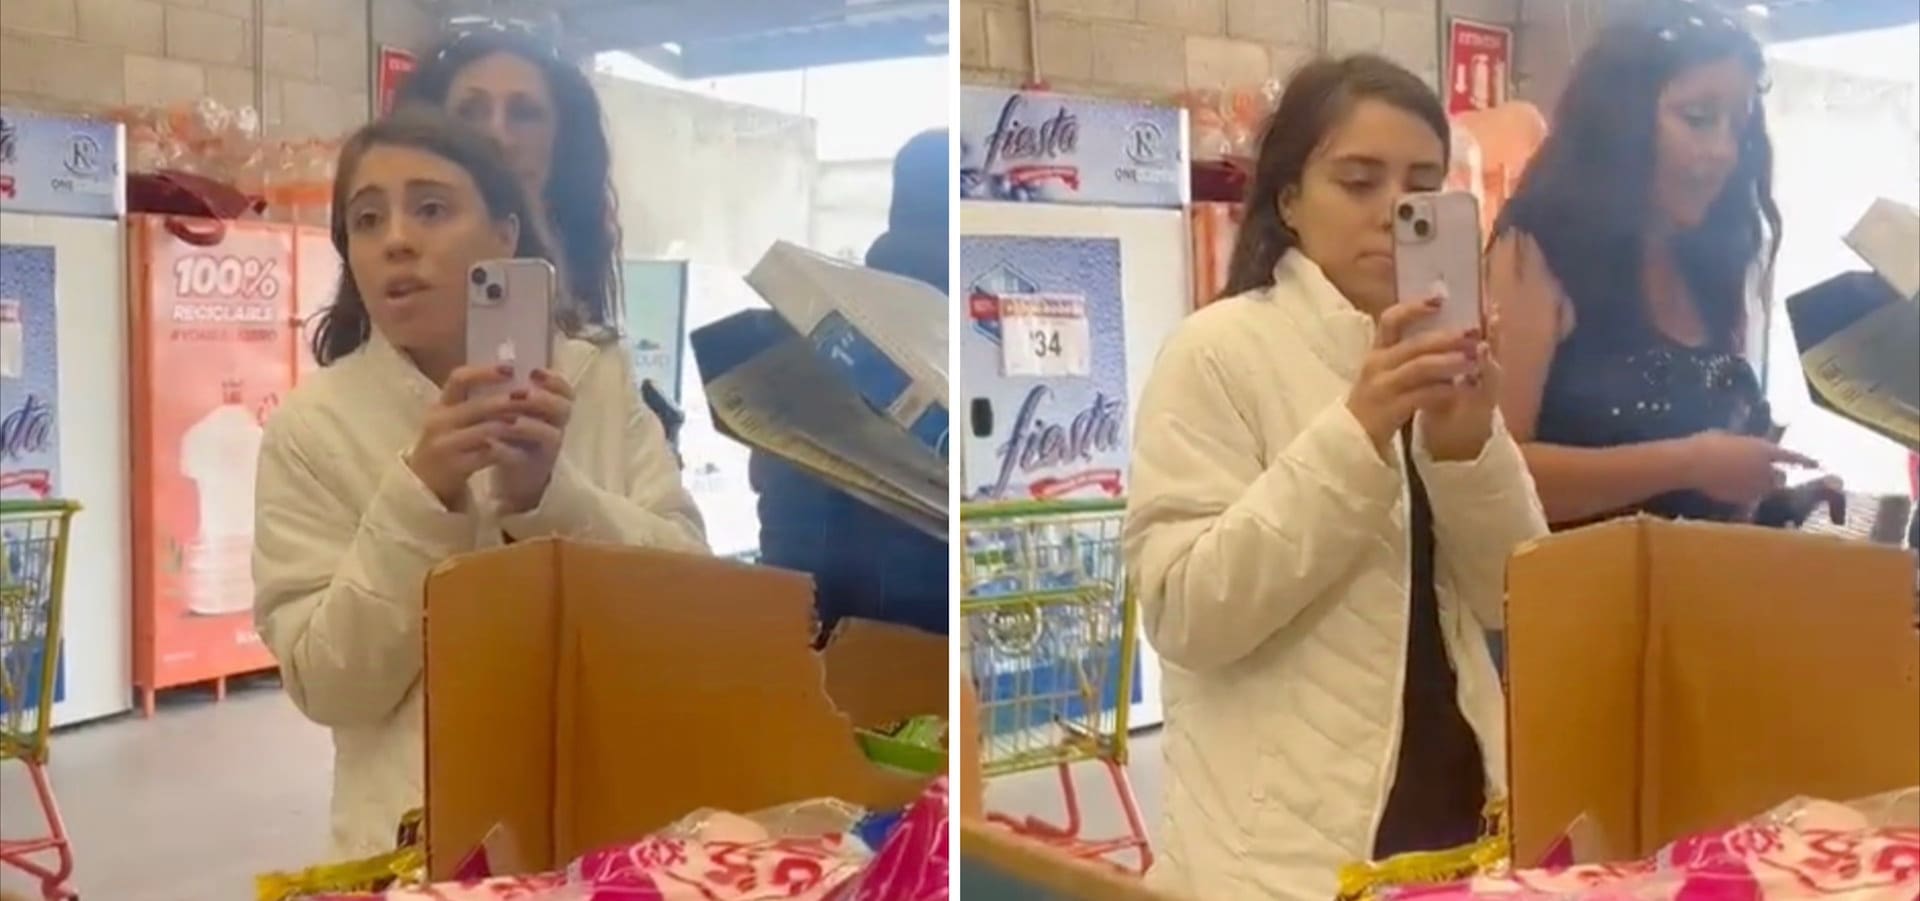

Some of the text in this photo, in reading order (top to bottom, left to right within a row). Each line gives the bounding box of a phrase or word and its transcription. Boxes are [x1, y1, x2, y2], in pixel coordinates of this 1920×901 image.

[983, 94, 1079, 173] fiesta
[174, 254, 279, 300] 100%
[172, 304, 275, 322] RECICLABLE
[997, 384, 1122, 497] fiesta
